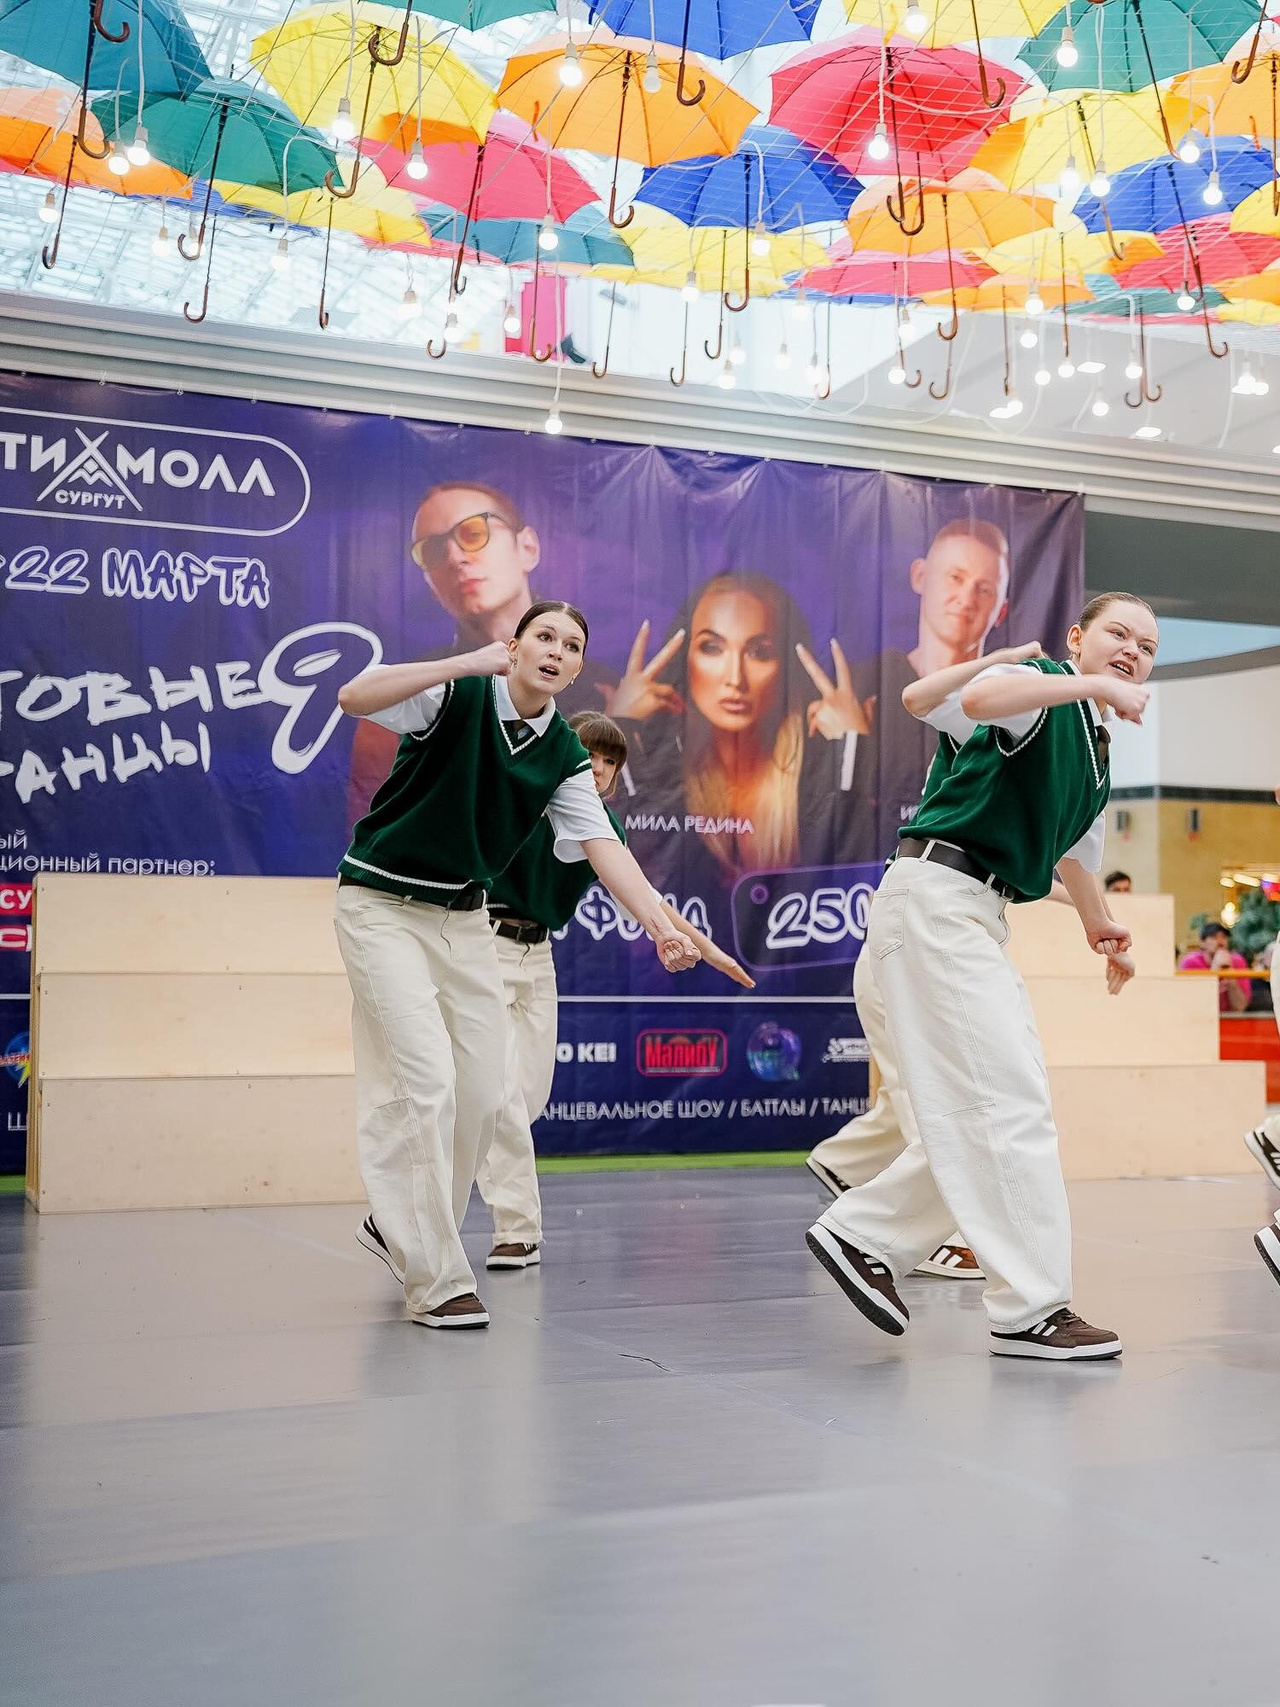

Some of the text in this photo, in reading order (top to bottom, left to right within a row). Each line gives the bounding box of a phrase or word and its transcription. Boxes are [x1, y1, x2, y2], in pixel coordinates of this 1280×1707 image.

[0, 431, 276, 497] ТИ МОЛЛ
[54, 488, 127, 509] СУРГУТ
[0, 545, 271, 609] 22 МАРТА
[625, 813, 755, 835] МИЛА РЕДИНА
[108, 856, 216, 877] партнер:
[537, 1100, 674, 1121] АНЦЕВАЛЬНОЕ
[678, 1099, 725, 1119] ШОУ
[740, 1098, 806, 1117] БАТТЛЫ
